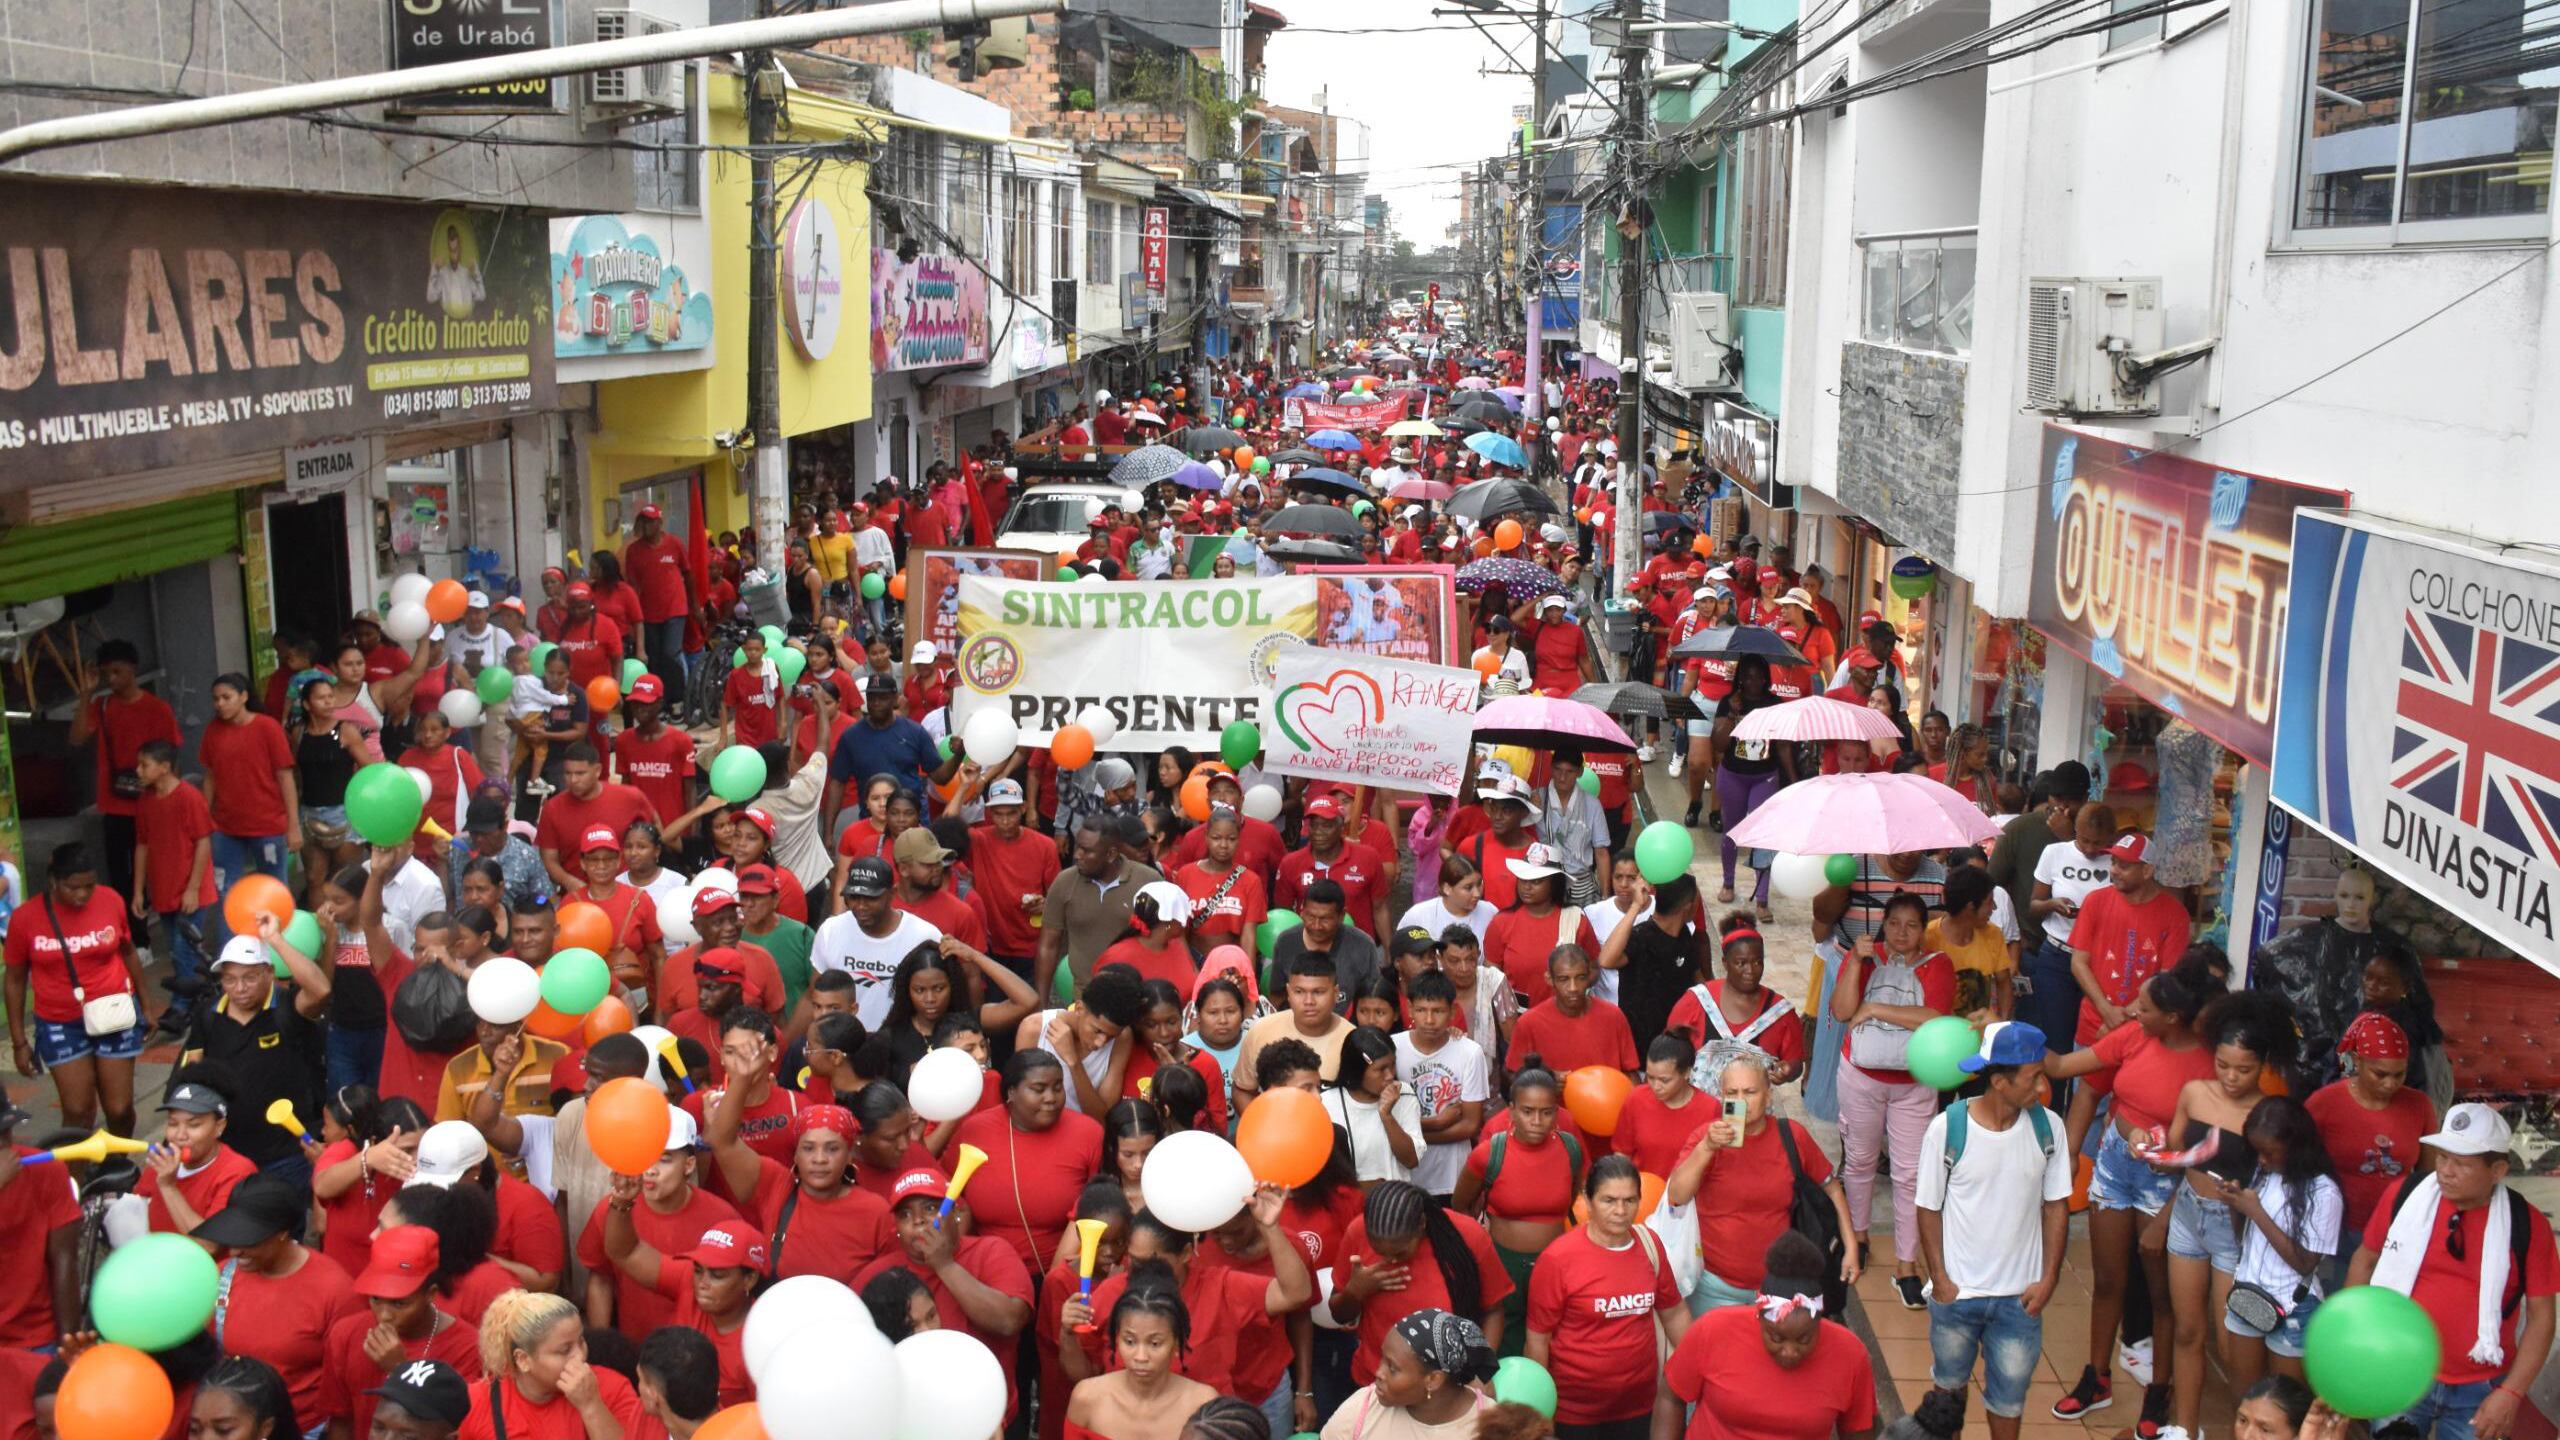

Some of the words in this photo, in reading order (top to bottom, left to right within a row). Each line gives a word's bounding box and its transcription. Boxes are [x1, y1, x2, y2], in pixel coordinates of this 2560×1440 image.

[413, 25, 443, 46] de
[458, 24, 536, 46] Urabá
[1149, 213, 1162, 282] ROYAL
[594, 241, 661, 288] PAÑALERA
[364, 309, 437, 355] Crédito
[443, 309, 529, 350] Inmediato
[41, 404, 171, 445] MULTIMUEBLE
[182, 398, 228, 427] MESA
[231, 396, 251, 420] TV
[263, 389, 335, 417] SOPORTES
[336, 384, 353, 407] TV
[384, 392, 411, 419] (034)
[413, 390, 433, 411] 815
[434, 388, 458, 409] 0801
[473, 385, 490, 405] 313
[492, 384, 508, 403] 763
[510, 382, 531, 400] 3909
[297, 451, 354, 480] ENTRADA
[1002, 588, 1272, 629] SINTRACOL
[2056, 478, 2290, 724] OUTLET
[1392, 670, 1475, 715] RANGEL
[1769, 683, 1800, 695] ANGEL
[630, 763, 672, 773] RANGEL
[851, 868, 878, 879] PRADA
[1304, 872, 1314, 885] R
[2062, 866, 2091, 881] CO
[2382, 799, 2554, 941] DINASTÍA
[1189, 896, 1242, 911] RAGEL
[844, 955, 898, 973] Reebo
[896, 1173, 935, 1193] RANGEL
[400, 1360, 436, 1388] NY
